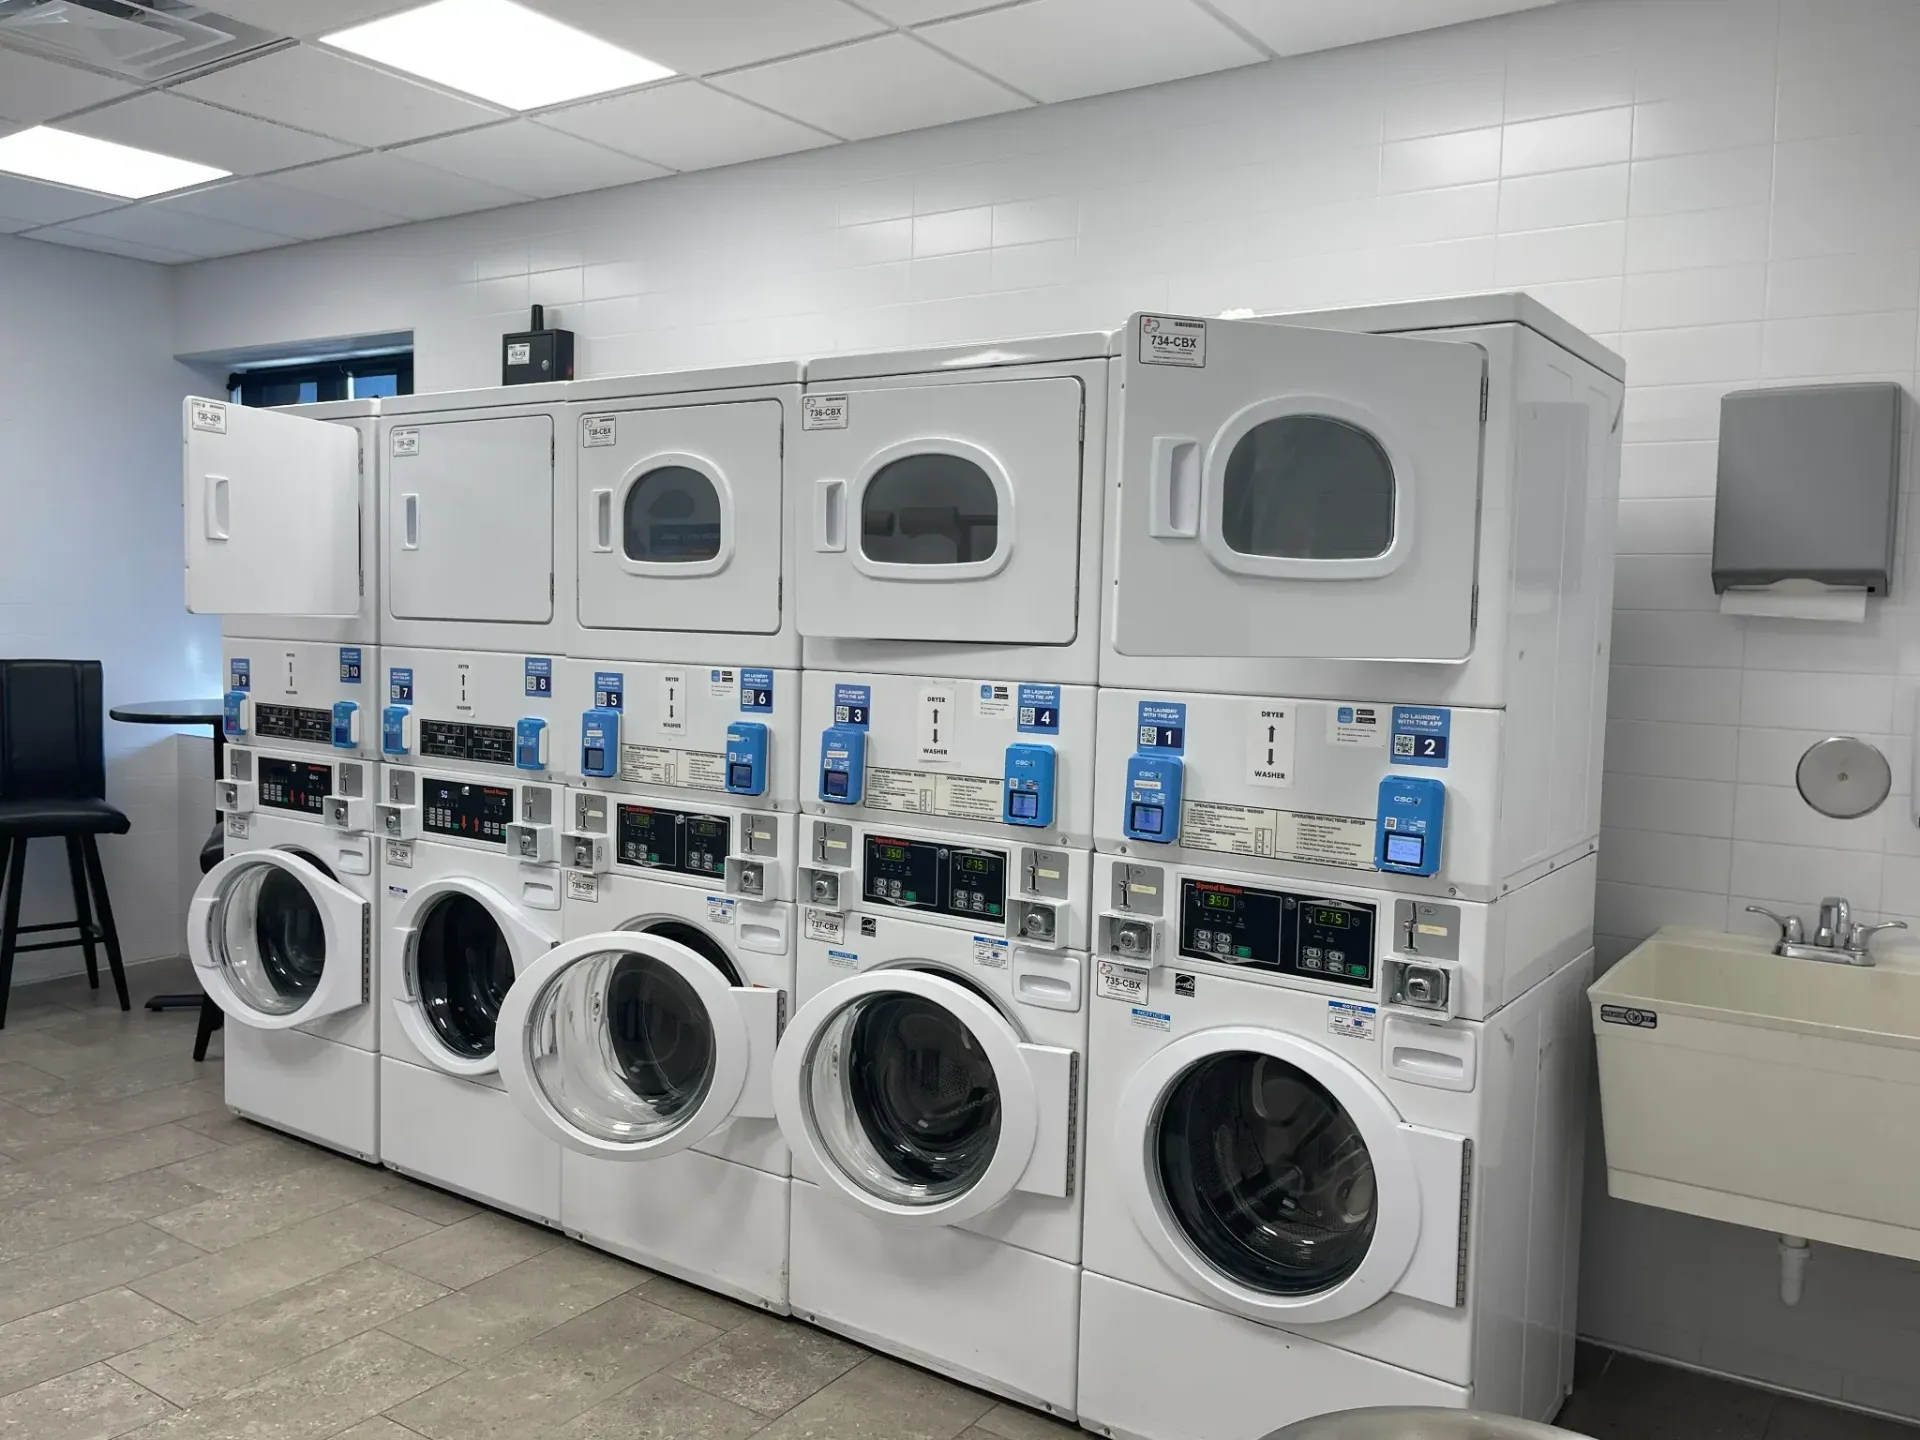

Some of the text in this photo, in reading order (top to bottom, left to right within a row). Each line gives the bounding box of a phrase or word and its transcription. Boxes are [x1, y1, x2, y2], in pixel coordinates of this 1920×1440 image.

[1151, 335, 1197, 348] 734-CBX
[810, 407, 842, 416] 736-CBX
[350, 667, 358, 676] 10
[241, 675, 247, 685] 9
[540, 678, 546, 690] 8
[403, 687, 408, 698] 7
[759, 692, 766, 704] 6
[611, 694, 617, 706] 5
[854, 709, 862, 722] 3
[1041, 711, 1050, 725] 4
[1165, 730, 1172, 745] 1
[1424, 738, 1436, 755] 2
[1254, 770, 1285, 779] WASHER
[1216, 804, 1245, 812] INSTRUCTIONS
[1316, 815, 1347, 824] INSTRUCTIONS
[886, 848, 902, 858] 350
[966, 859, 984, 870] 275
[1196, 882, 1243, 895] Speed Queen
[1209, 894, 1230, 907] 350
[1319, 911, 1342, 925] 275
[812, 920, 839, 931] 737-CBX
[1105, 976, 1141, 990] 735-CBX
[1137, 1010, 1166, 1019] NOTICE
